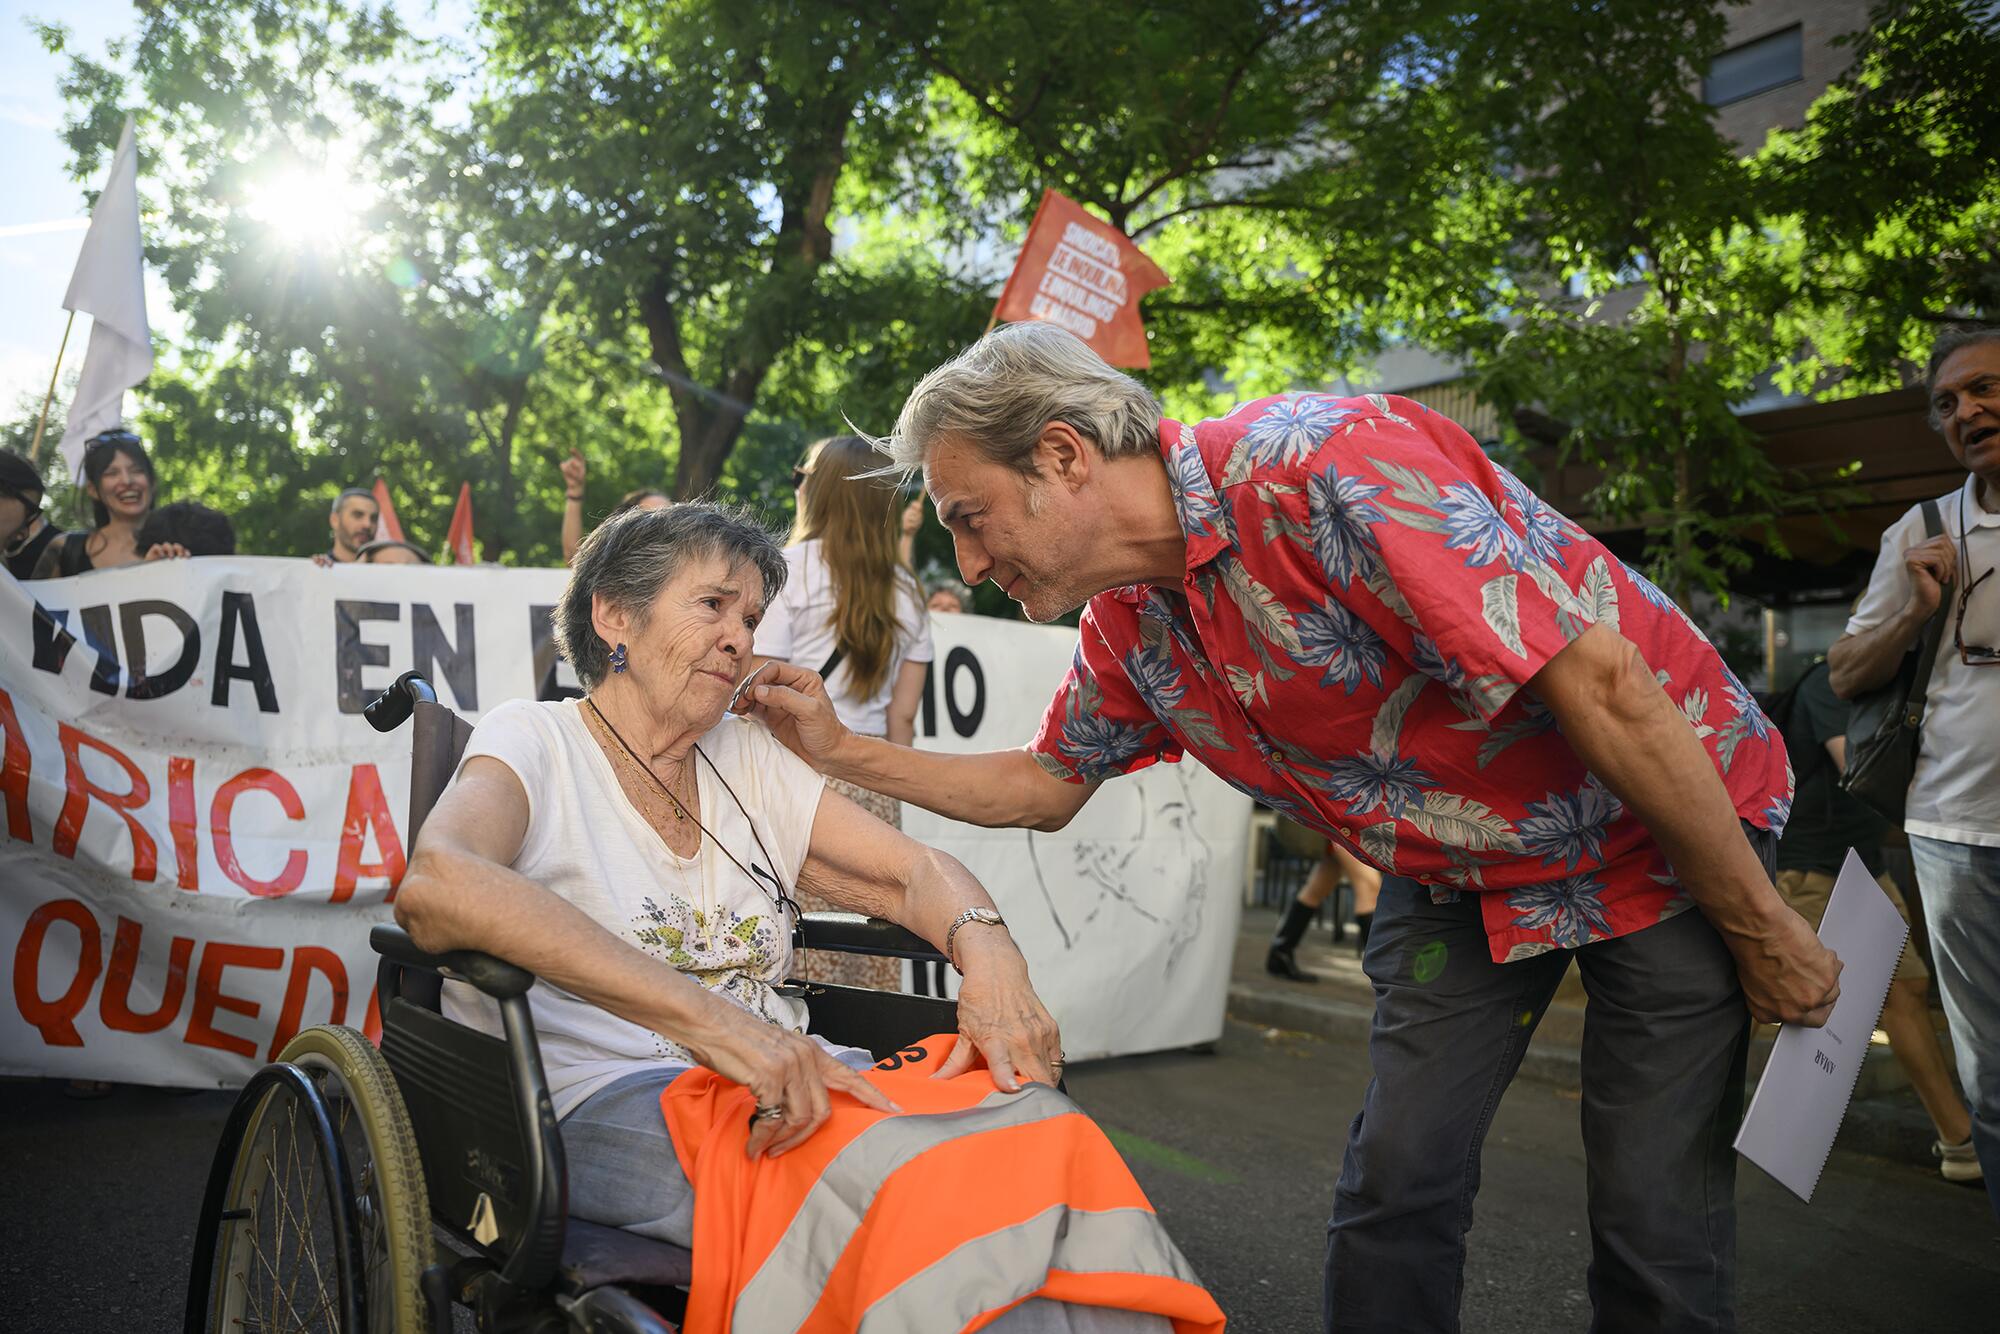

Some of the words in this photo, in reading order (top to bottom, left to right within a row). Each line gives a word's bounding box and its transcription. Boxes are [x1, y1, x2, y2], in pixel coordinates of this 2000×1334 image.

[32, 590, 280, 714] VIDA
[334, 601, 479, 714] EN
[1814, 1049, 1837, 1075] AMAR
